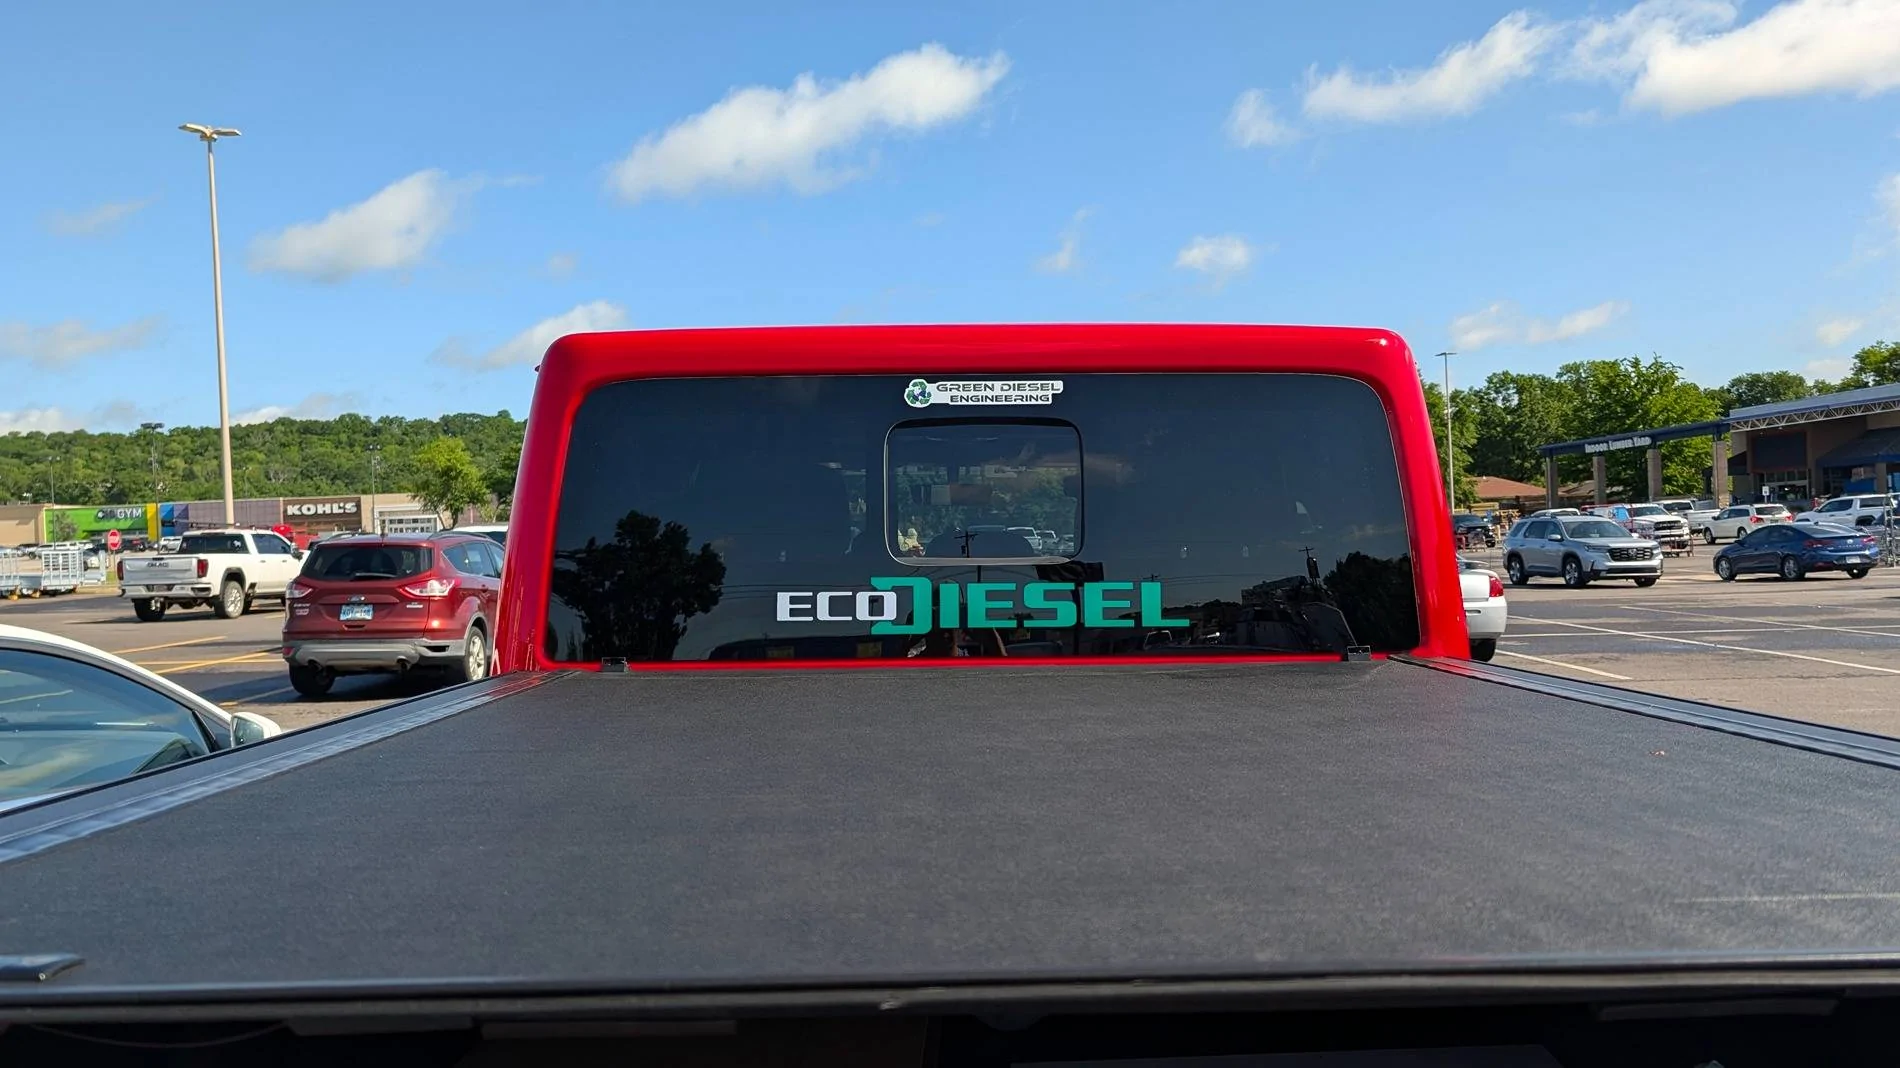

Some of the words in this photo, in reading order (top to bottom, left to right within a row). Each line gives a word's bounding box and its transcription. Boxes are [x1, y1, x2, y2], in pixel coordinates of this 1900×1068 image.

[936, 383, 995, 392] GREEN
[1000, 382, 1061, 391] DIESEL
[950, 394, 1050, 403] ENGINEERING
[286, 502, 358, 516] KOHL'S
